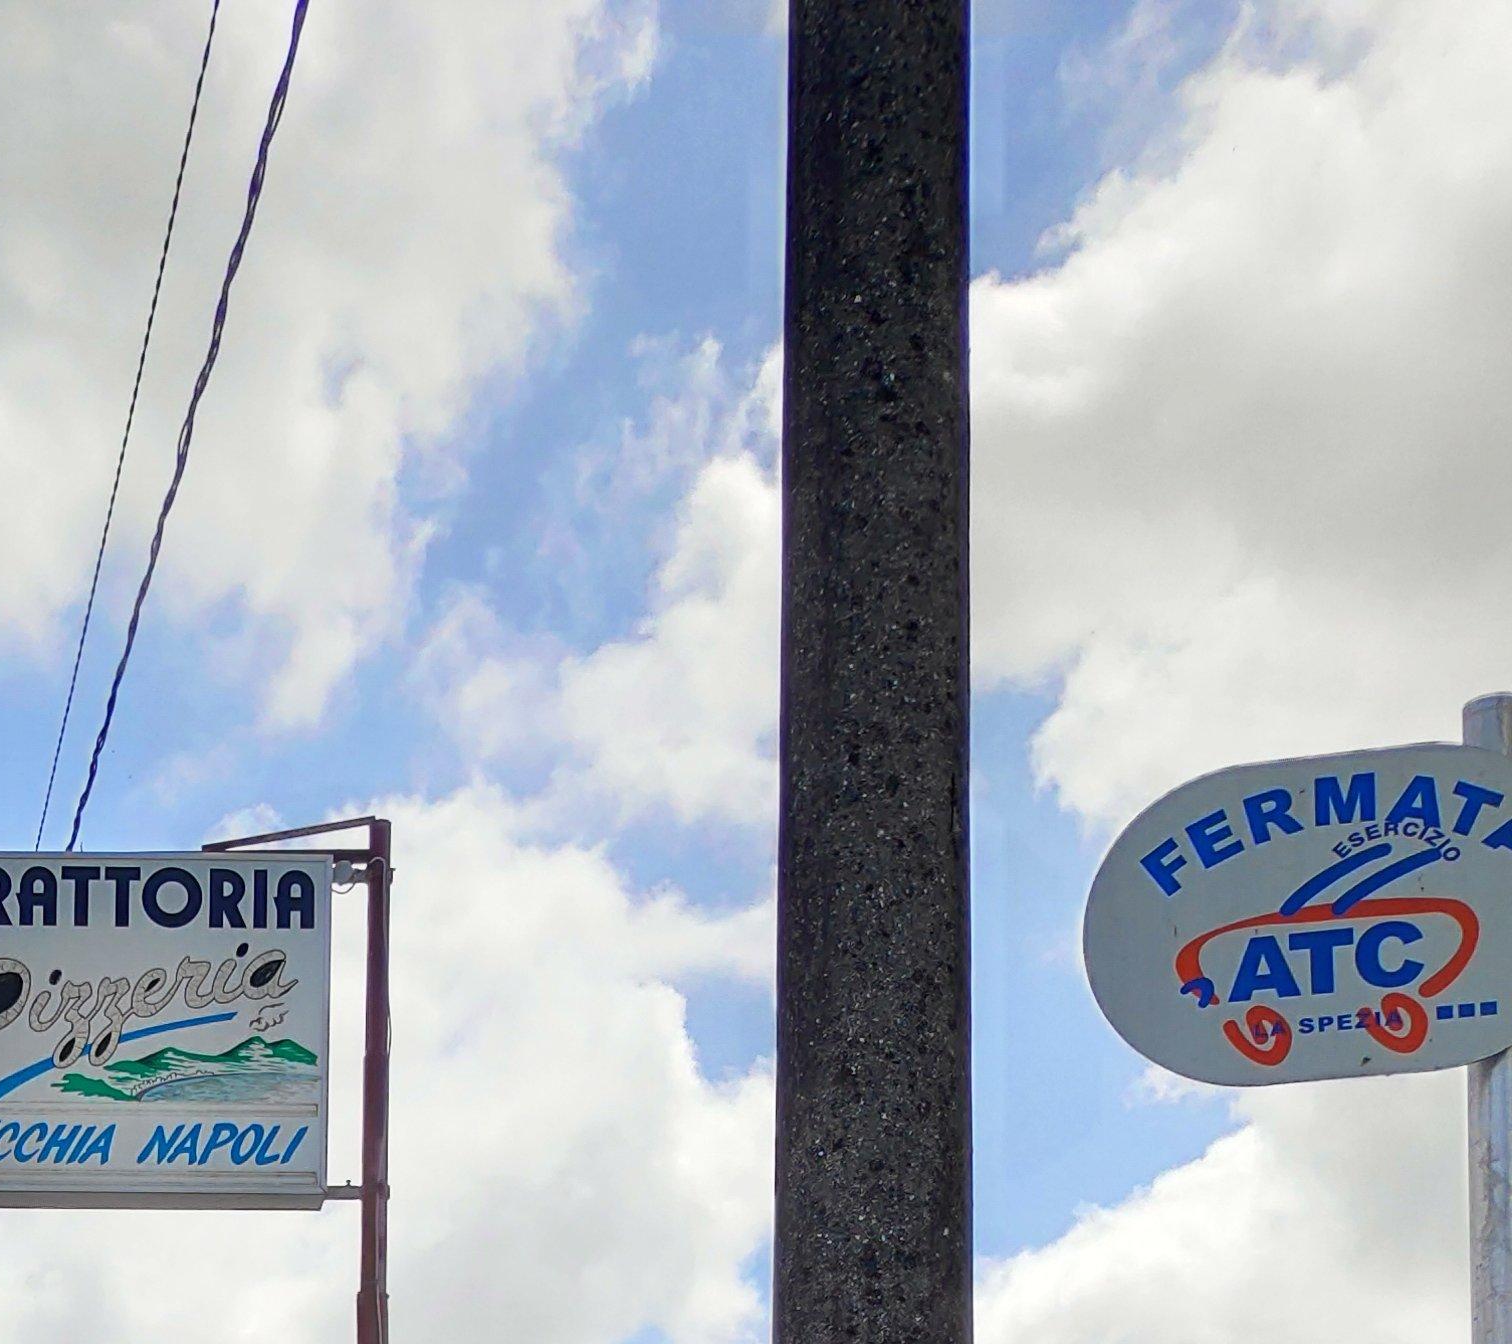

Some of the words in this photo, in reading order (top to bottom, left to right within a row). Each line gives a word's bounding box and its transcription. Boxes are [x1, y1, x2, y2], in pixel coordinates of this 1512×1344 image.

[1332, 820, 1461, 863] ESERCIZIO
[1228, 920, 1425, 1003] ATC
[1253, 1019, 1286, 1039] LA
[1298, 1009, 1403, 1034] SPEZIA
[136, 1122, 308, 1166] NAPOLI
